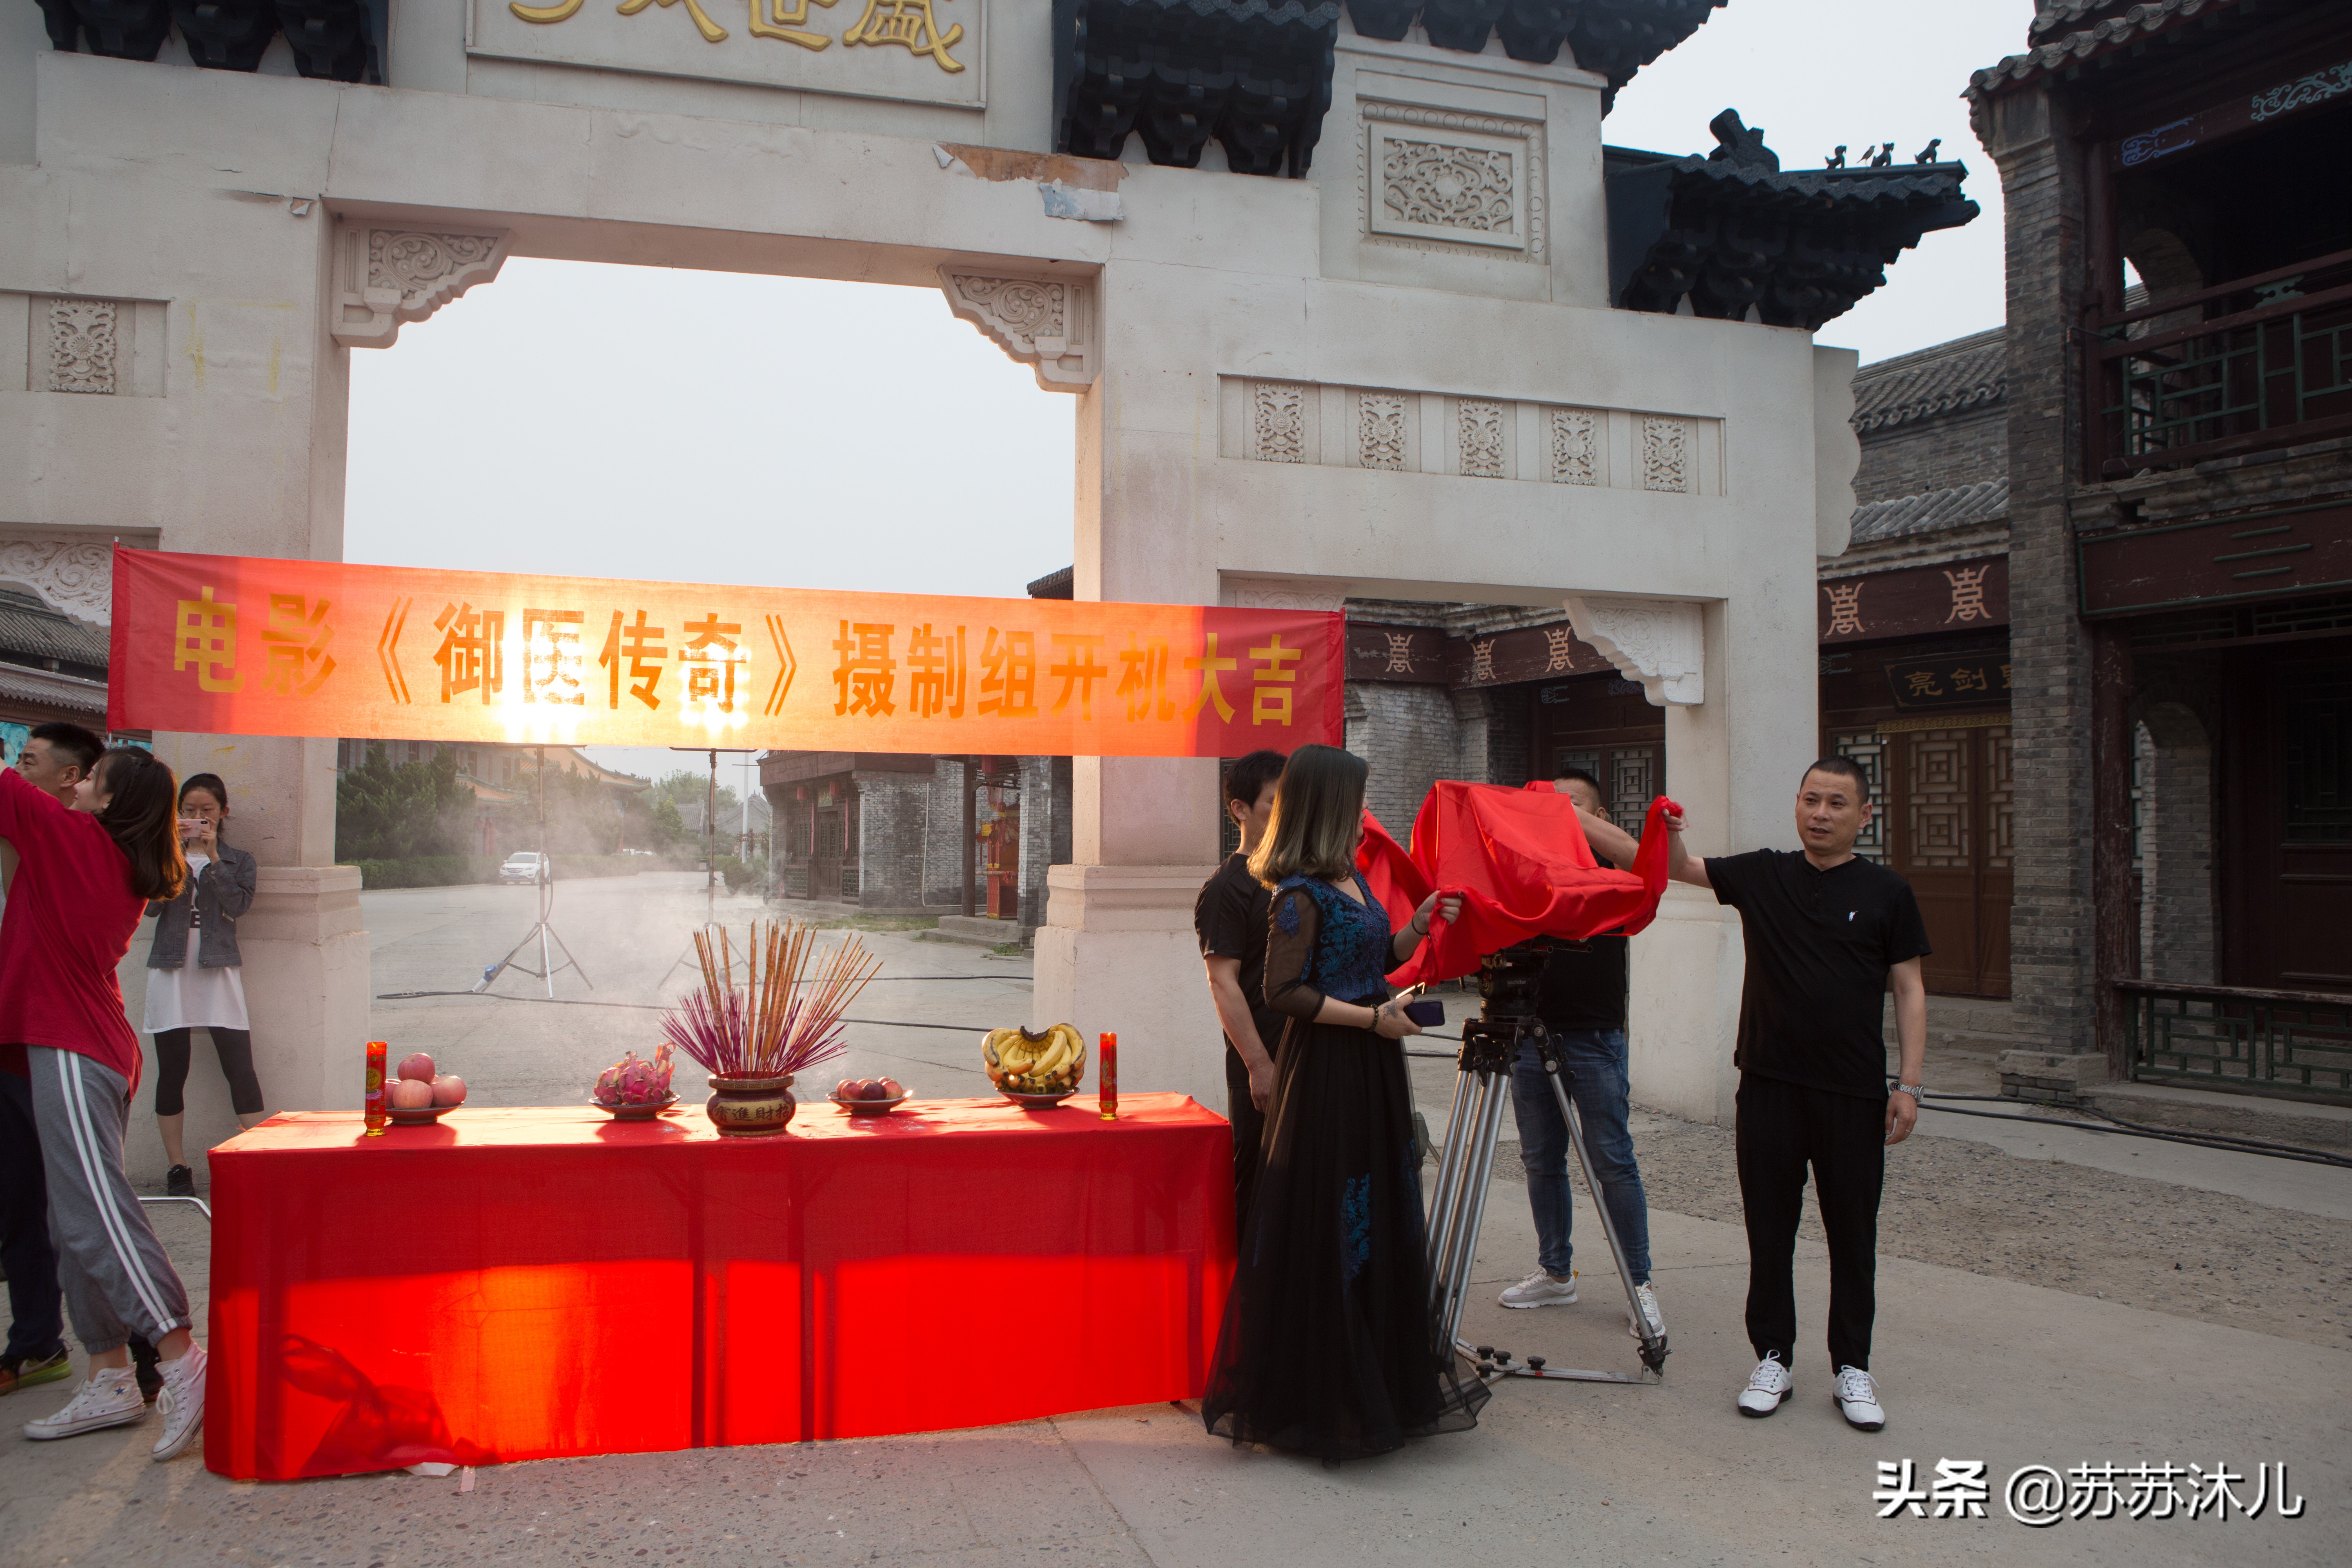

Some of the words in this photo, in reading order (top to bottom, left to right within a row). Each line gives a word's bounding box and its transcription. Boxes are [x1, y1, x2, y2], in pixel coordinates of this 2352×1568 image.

[173, 585, 1303, 727] 电影《御医传奇》摄制组开机大吉
